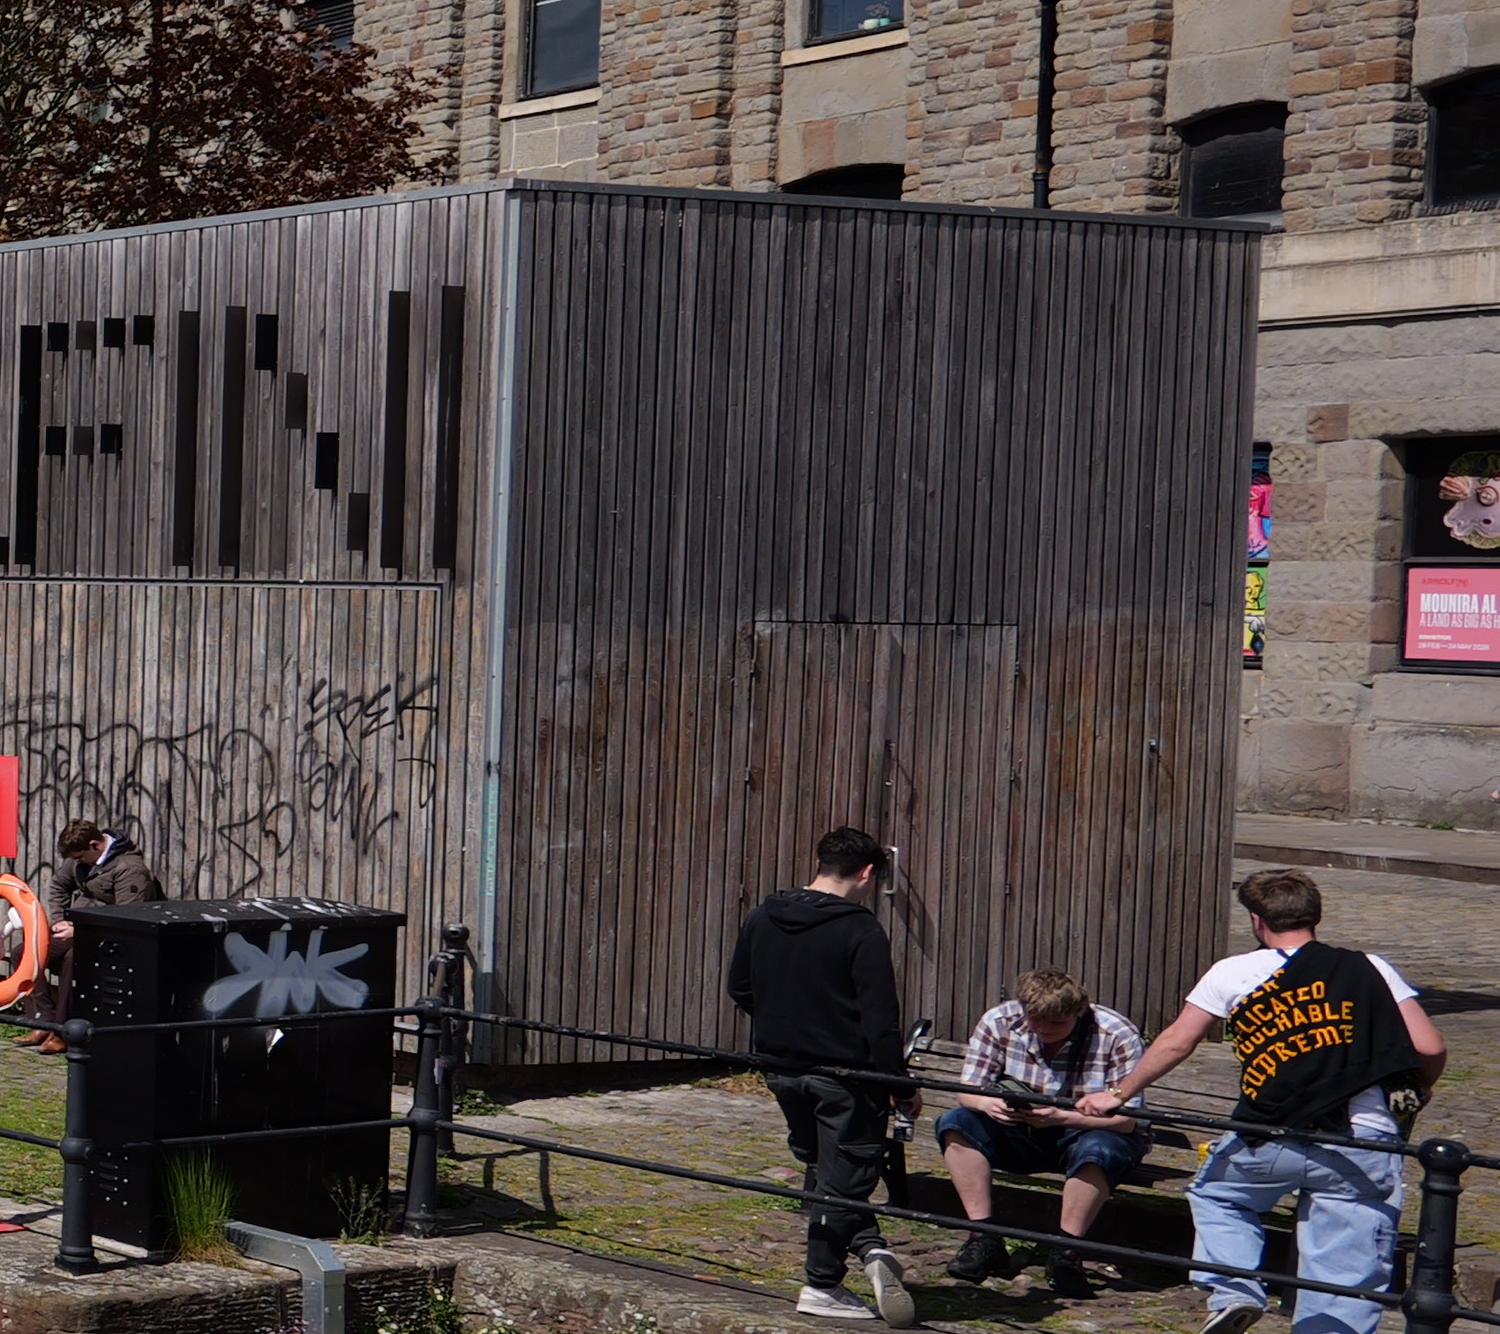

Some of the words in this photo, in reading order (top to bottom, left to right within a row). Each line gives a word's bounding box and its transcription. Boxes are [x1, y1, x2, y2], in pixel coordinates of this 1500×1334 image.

[1419, 613, 1426, 627] A
[1427, 613, 1450, 627] LAND
[1451, 613, 1463, 628] AS
[1480, 614, 1492, 629] AS
[1420, 593, 1479, 613] MOUNIRA
[1481, 593, 1497, 614] AL
[1236, 980, 1325, 1033] LICATED
[1241, 1024, 1354, 1101] SUPREME
